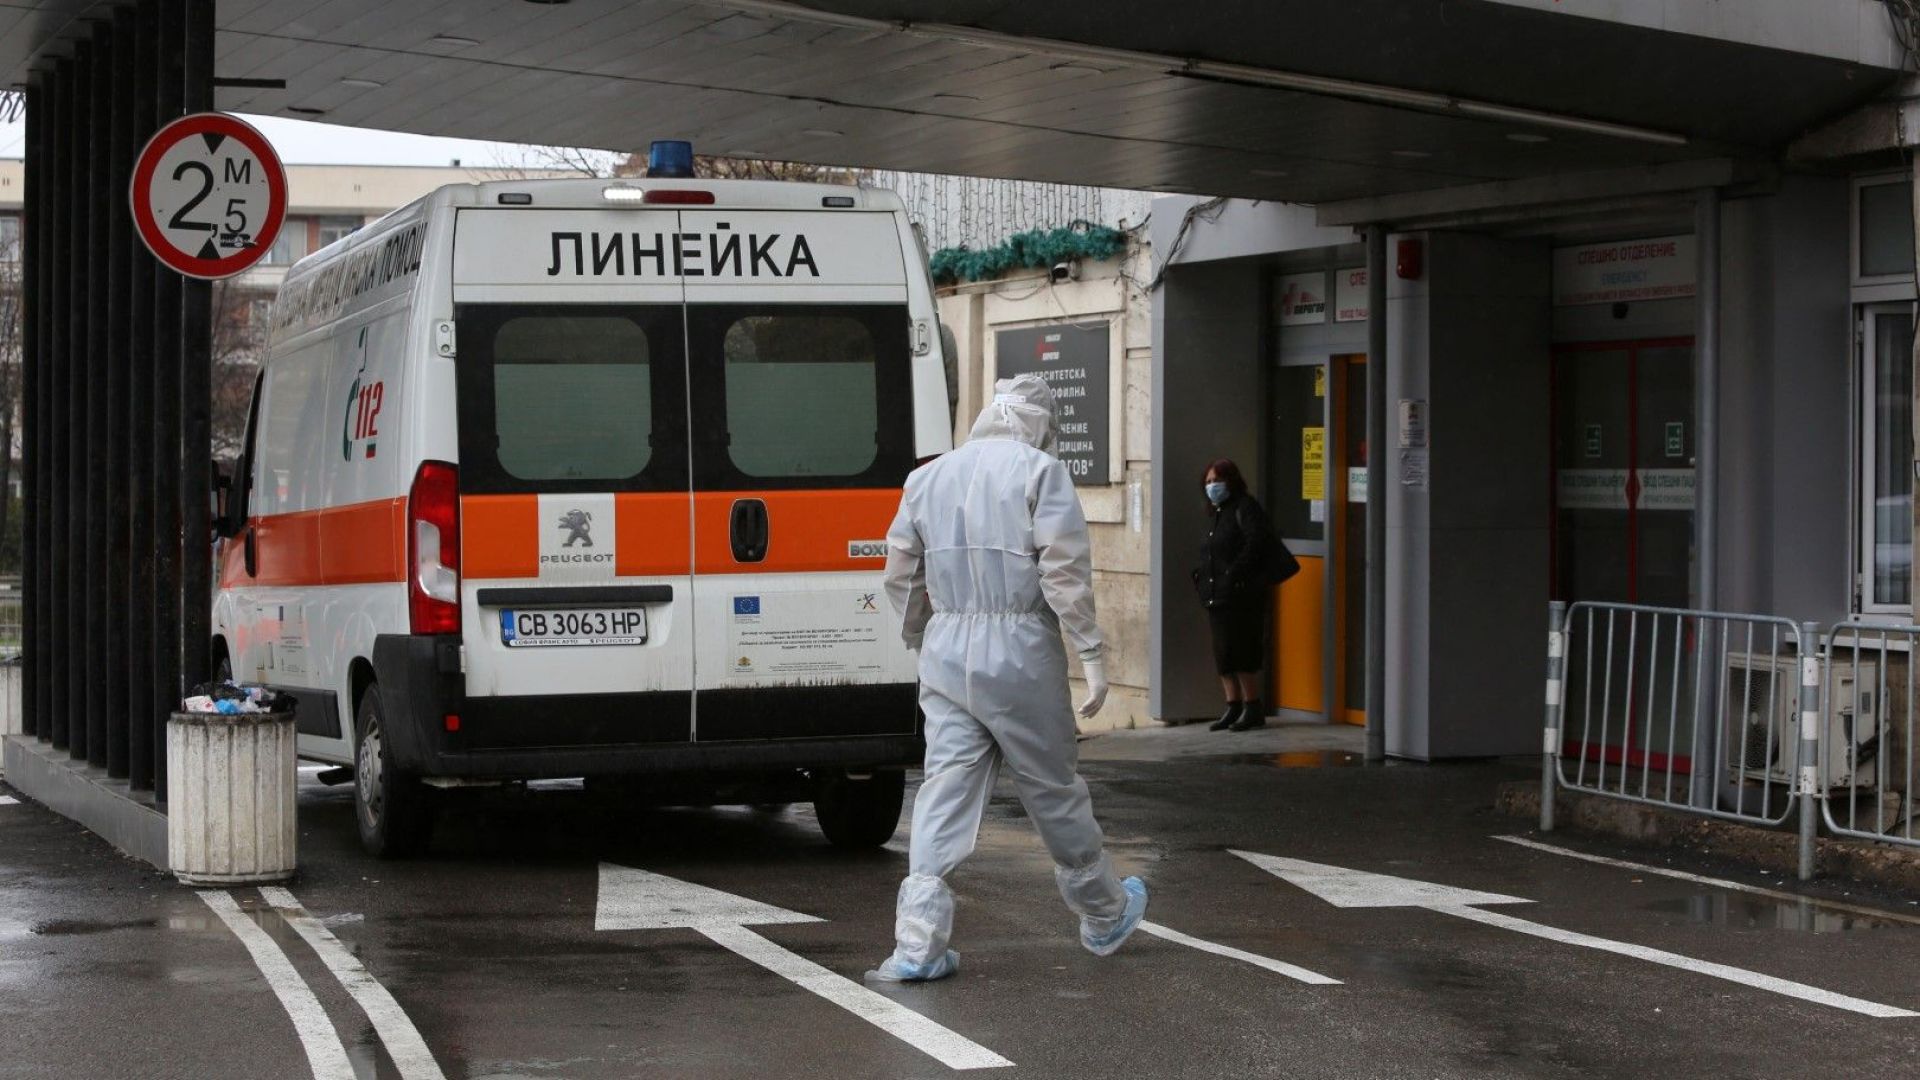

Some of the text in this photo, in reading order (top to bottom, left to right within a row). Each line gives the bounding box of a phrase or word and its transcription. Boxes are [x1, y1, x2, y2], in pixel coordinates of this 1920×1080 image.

[547, 222, 819, 277] ЛИНЕЙКА
[1578, 242, 1676, 265] СПЕШНО ОТДЕЛЕНИЕ
[1350, 272, 1367, 286] СПЕ
[355, 381, 384, 440] 112
[1063, 405, 1075, 416] ЗА
[1059, 422, 1089, 434] ЧЕНИЕ
[1059, 440, 1094, 453] ДИЦИНА
[540, 554, 614, 563] PEUGEOT
[552, 612, 608, 635] 3063
